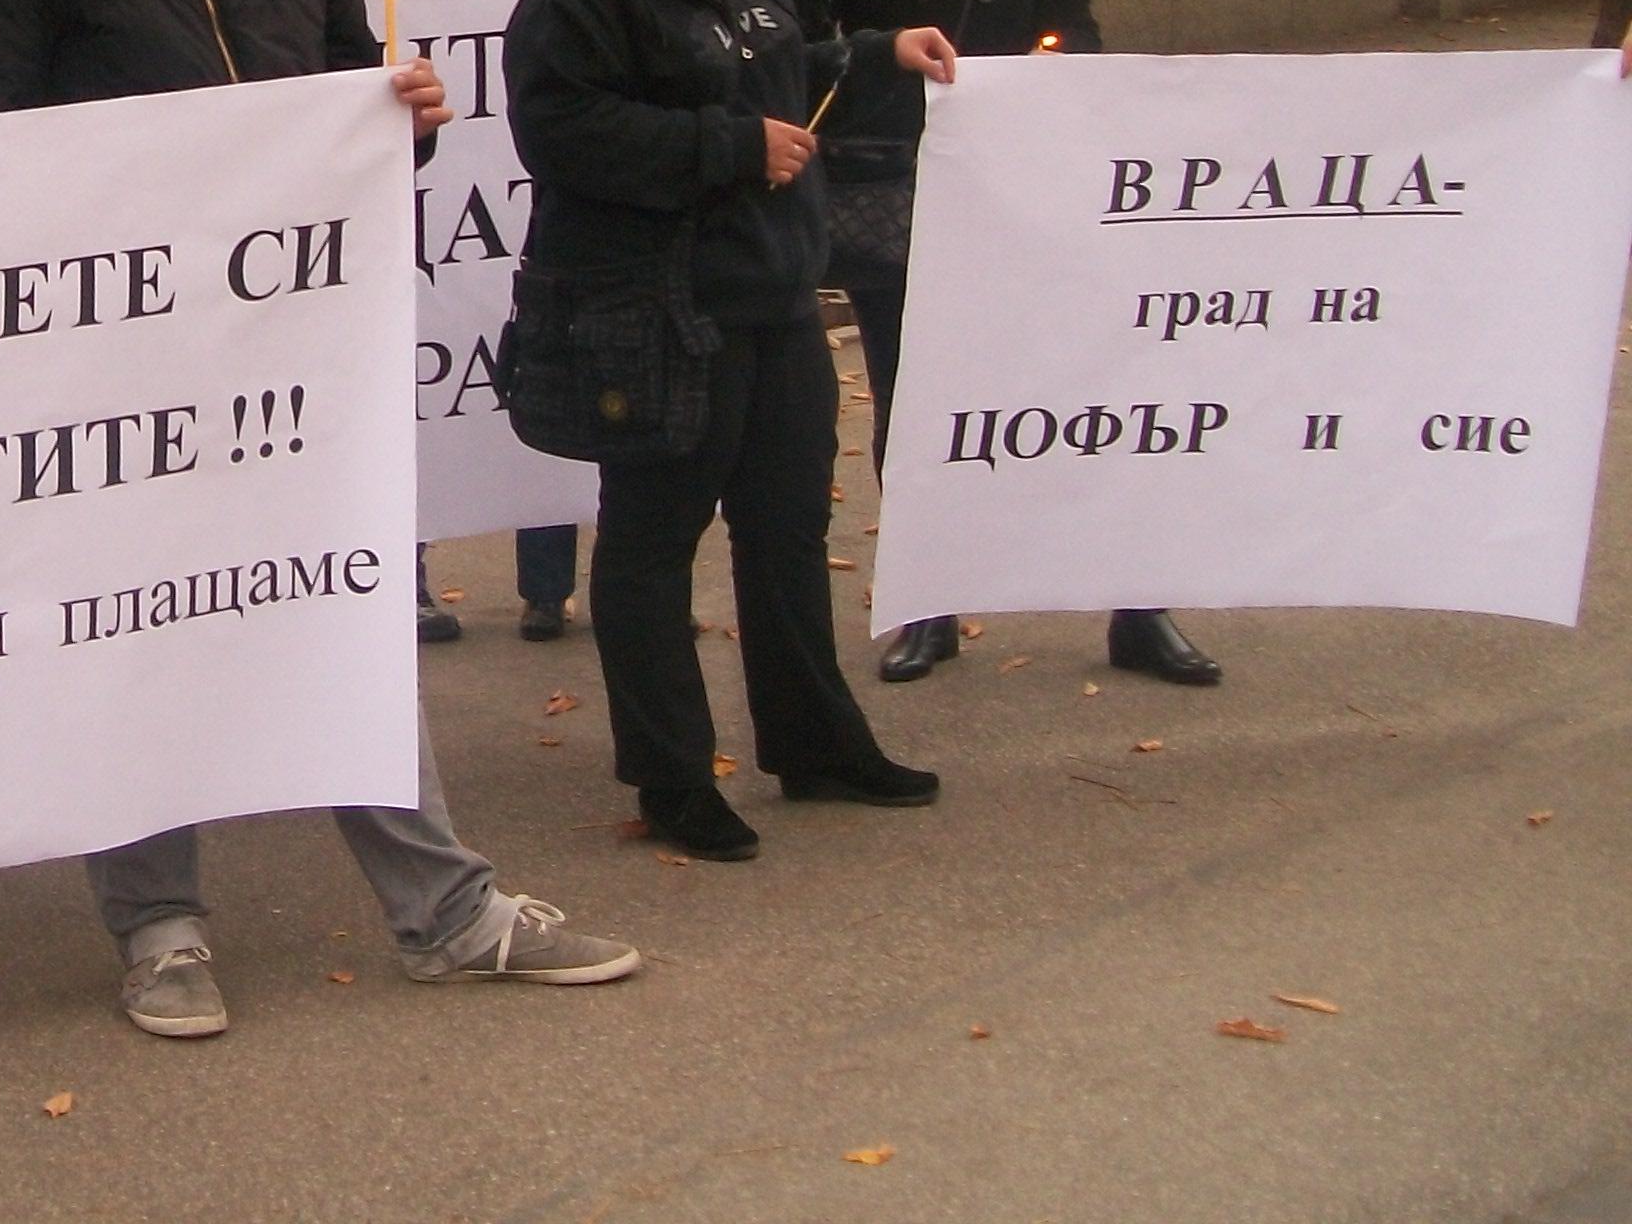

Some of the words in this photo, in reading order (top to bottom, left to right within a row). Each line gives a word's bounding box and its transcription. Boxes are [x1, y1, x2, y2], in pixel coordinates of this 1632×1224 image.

[226, 217, 351, 303] СИ
[1134, 289, 1272, 342] град
[1309, 286, 1380, 324] на
[943, 402, 1230, 472] ЦОФЪР
[1301, 413, 1342, 451] и
[1420, 413, 1531, 456] сие
[58, 547, 381, 648] плащаме
